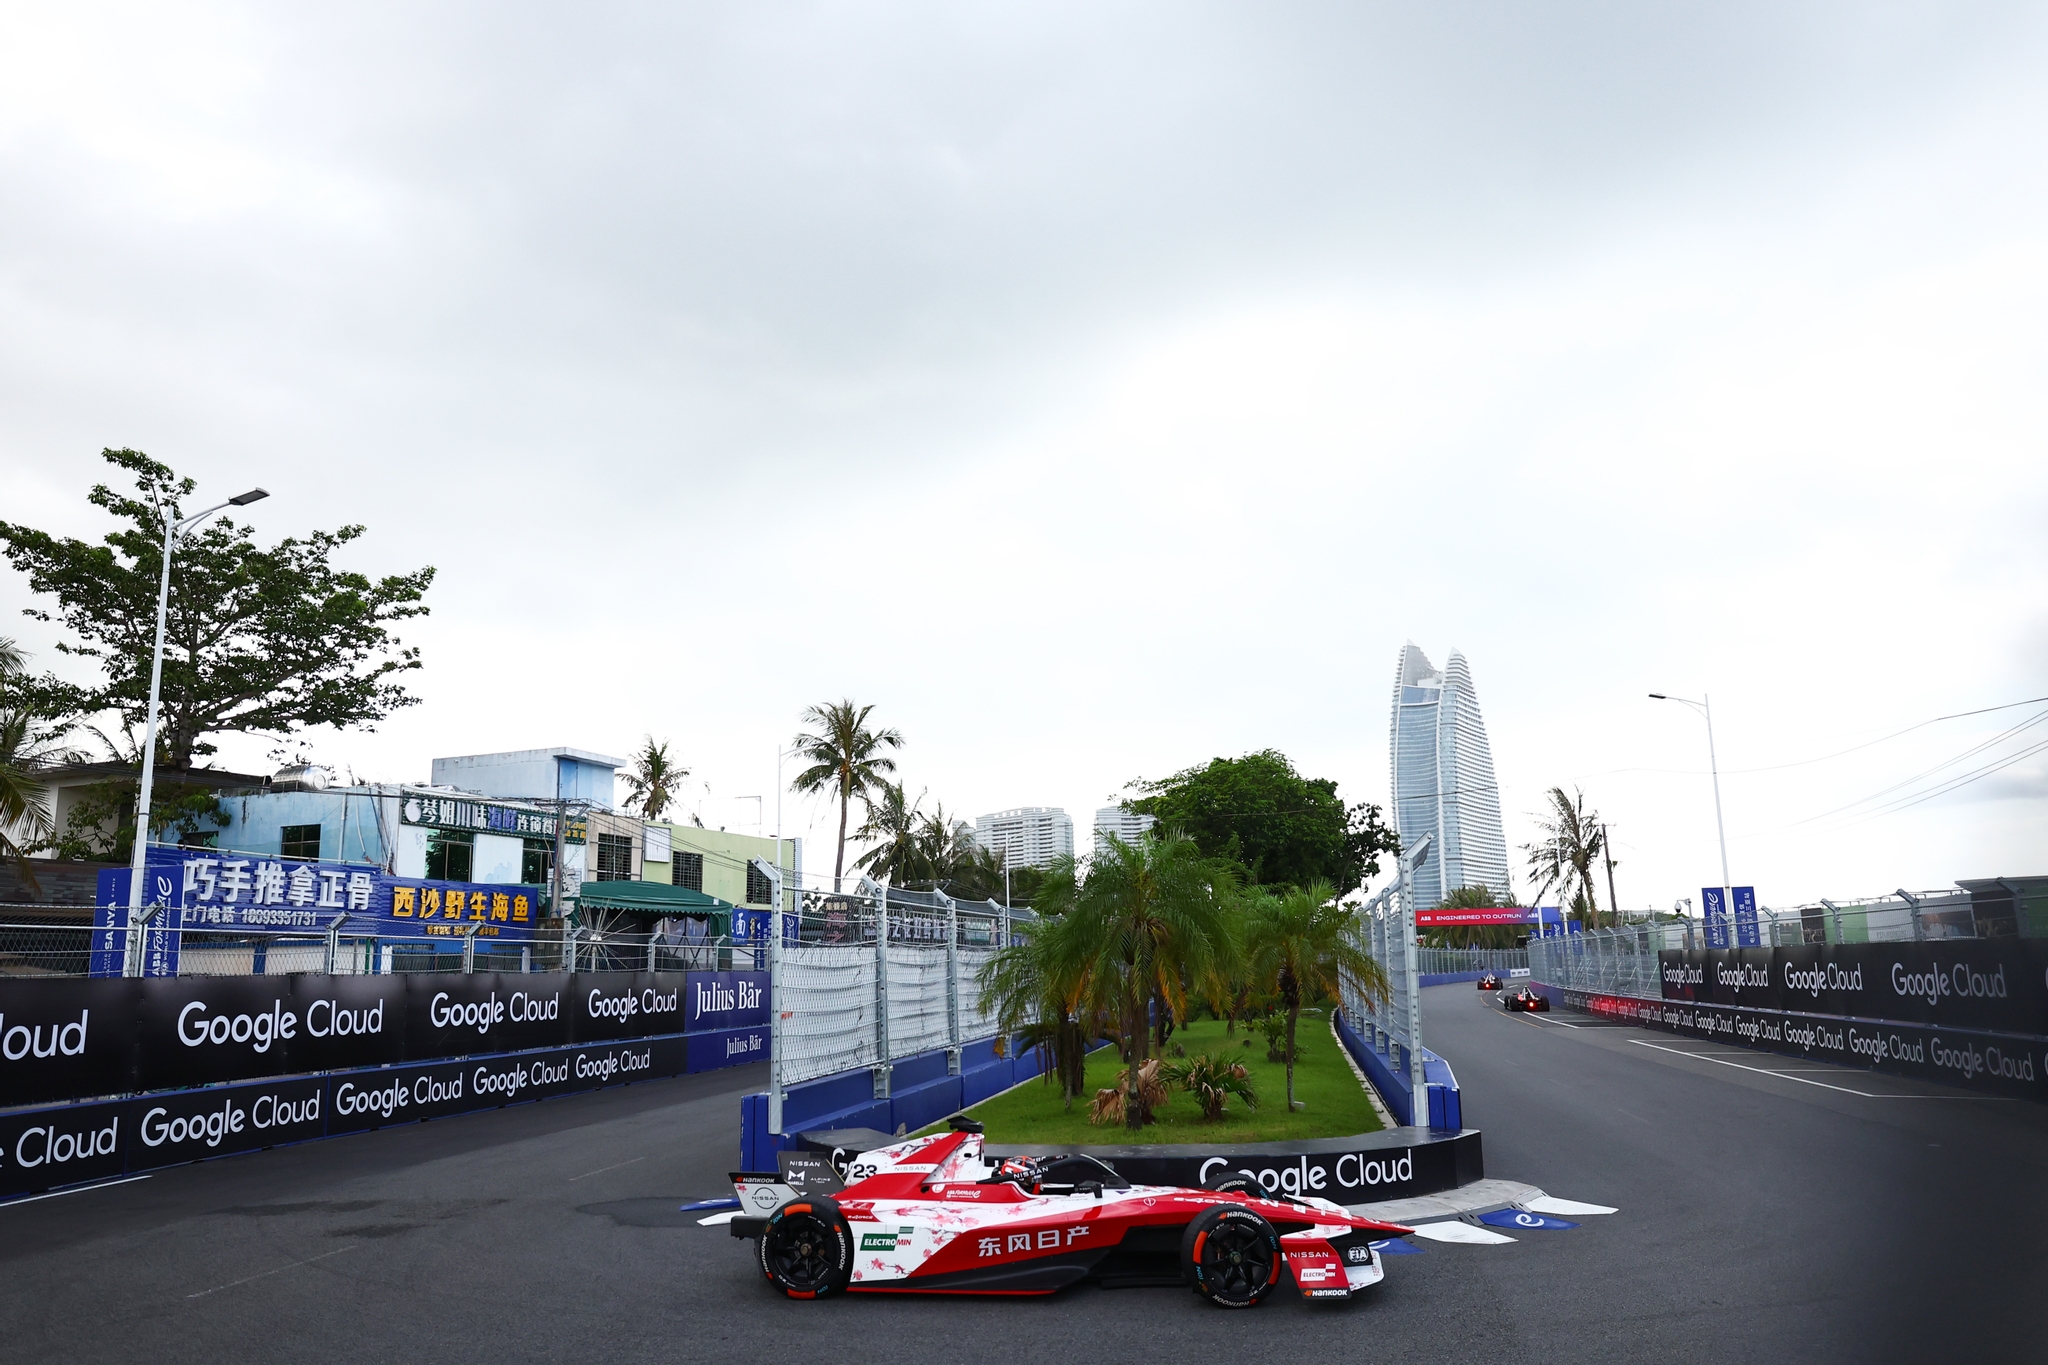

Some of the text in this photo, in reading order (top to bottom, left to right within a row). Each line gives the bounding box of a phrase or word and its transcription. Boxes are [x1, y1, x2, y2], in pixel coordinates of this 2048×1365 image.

[421, 798, 557, 836] 琴姐川味海鲜连锁餐
[183, 858, 374, 911] 巧手推拿正骨
[393, 886, 529, 922] 西沙野生海鱼
[104, 901, 116, 950] SANYA
[151, 952, 161, 976] ABB
[1663, 961, 1703, 990] Google Cloud
[1717, 961, 1769, 993] Google Cloud
[1784, 961, 1864, 998] Google Cloud
[694, 980, 763, 1021] Julius Bär
[1891, 961, 1951, 1006] Google
[1952, 962, 2007, 999] Cloud
[430, 991, 560, 1034] Google Cloud
[588, 987, 678, 1024] Google Cloud
[1638, 1003, 1662, 1023] Google Cloud
[1662, 1006, 1693, 1028] Google Cloud
[0, 1009, 89, 1061] oud
[177, 999, 384, 1053] Google Cloud
[1695, 1009, 1733, 1039] Google Cloud
[1735, 1014, 1781, 1043] Google Cloud
[1784, 1020, 1844, 1052] Google Cloud
[726, 1034, 763, 1059] Julius Bär
[1848, 1028, 1924, 1064] Google Cloud
[1930, 1037, 1984, 1079] Google
[1985, 1046, 2036, 1081] Cloud
[473, 1058, 569, 1098] Google Cloud
[575, 1047, 652, 1082] Google Cloud
[336, 1072, 464, 1118] Google Cloud
[140, 1089, 320, 1147] Google Cloud
[15, 1116, 119, 1168] Cloud
[853, 1164, 878, 1179] 23
[1013, 1166, 1049, 1179] NISSAN
[1335, 1148, 1414, 1188] Cloud
[864, 1238, 912, 1246] ELECTROMIN
[978, 1225, 1090, 1257] 东风日产
[1349, 1249, 1369, 1260] FIA
